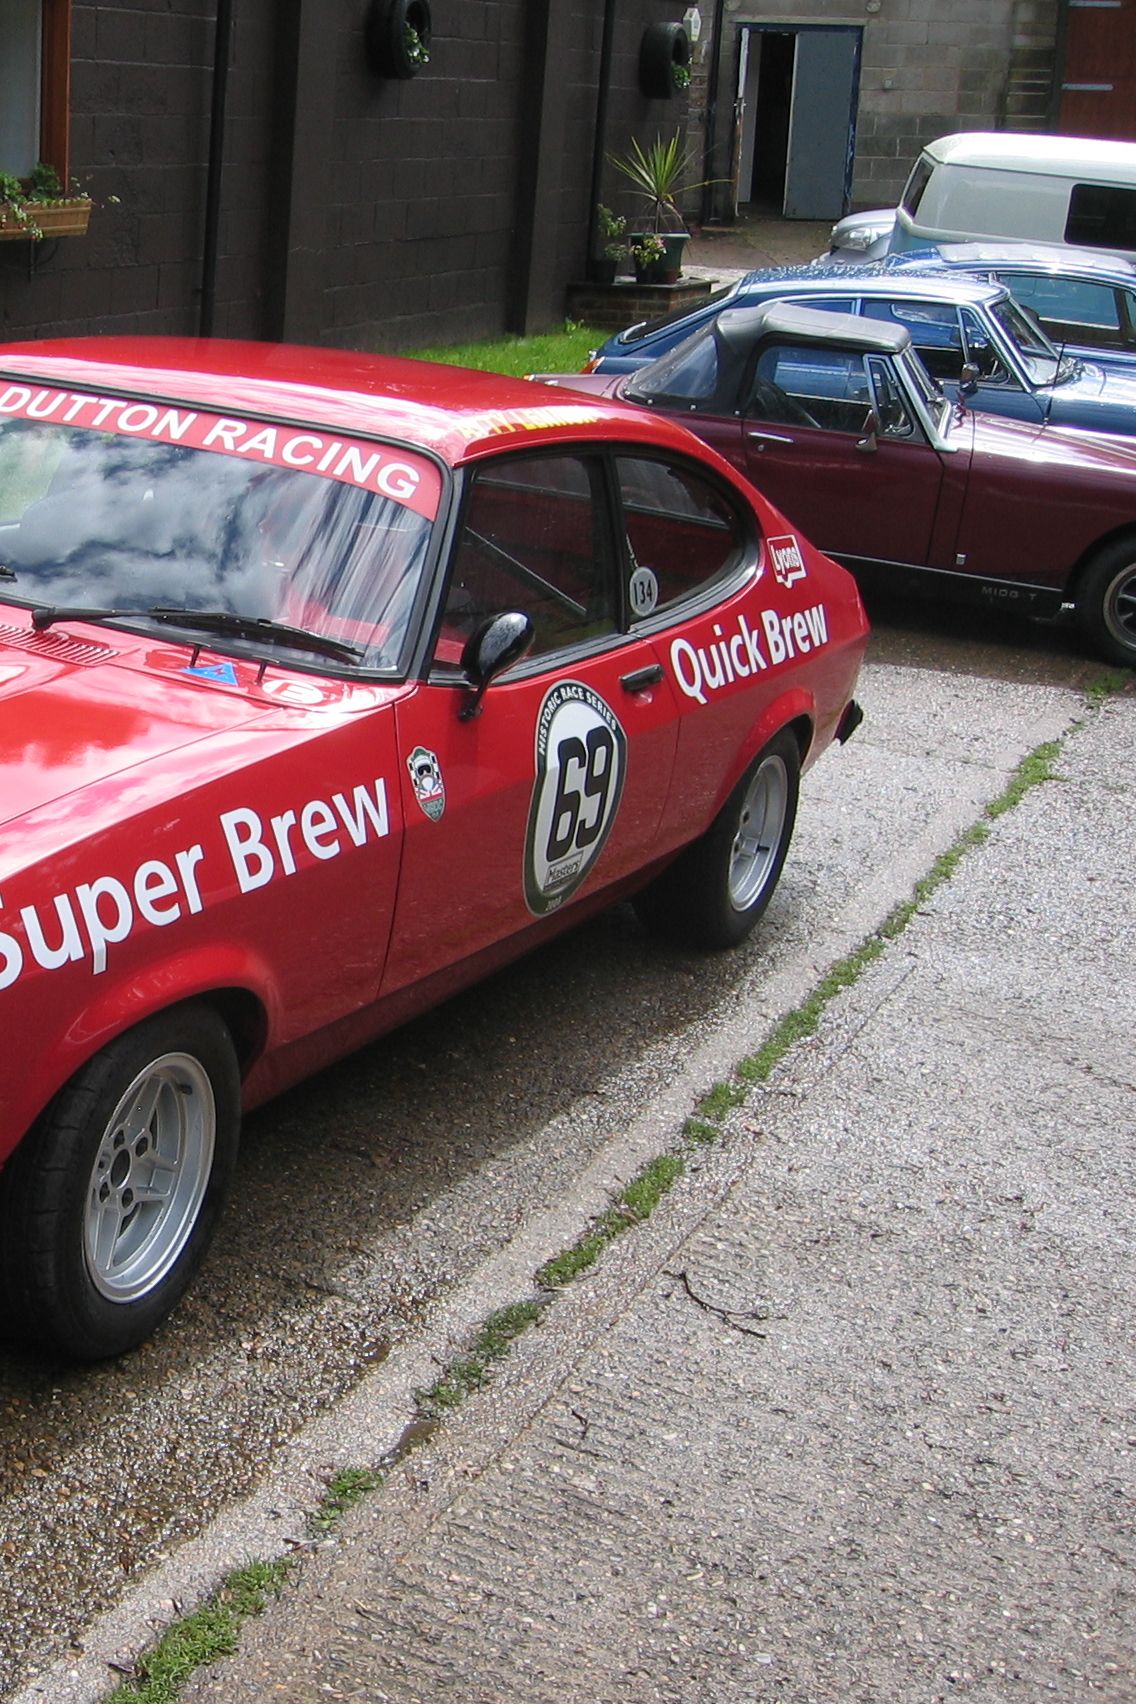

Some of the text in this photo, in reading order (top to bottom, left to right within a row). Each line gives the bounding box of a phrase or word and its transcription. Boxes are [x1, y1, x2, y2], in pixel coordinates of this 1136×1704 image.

[203, 417, 421, 500] RACING
[633, 581, 653, 605] 134
[770, 545, 800, 575] Lyons
[670, 604, 829, 705] Quick Brew
[538, 686, 618, 755] HISTORIC RACE SERIES
[546, 725, 614, 862] 69
[219, 777, 392, 894] Brew
